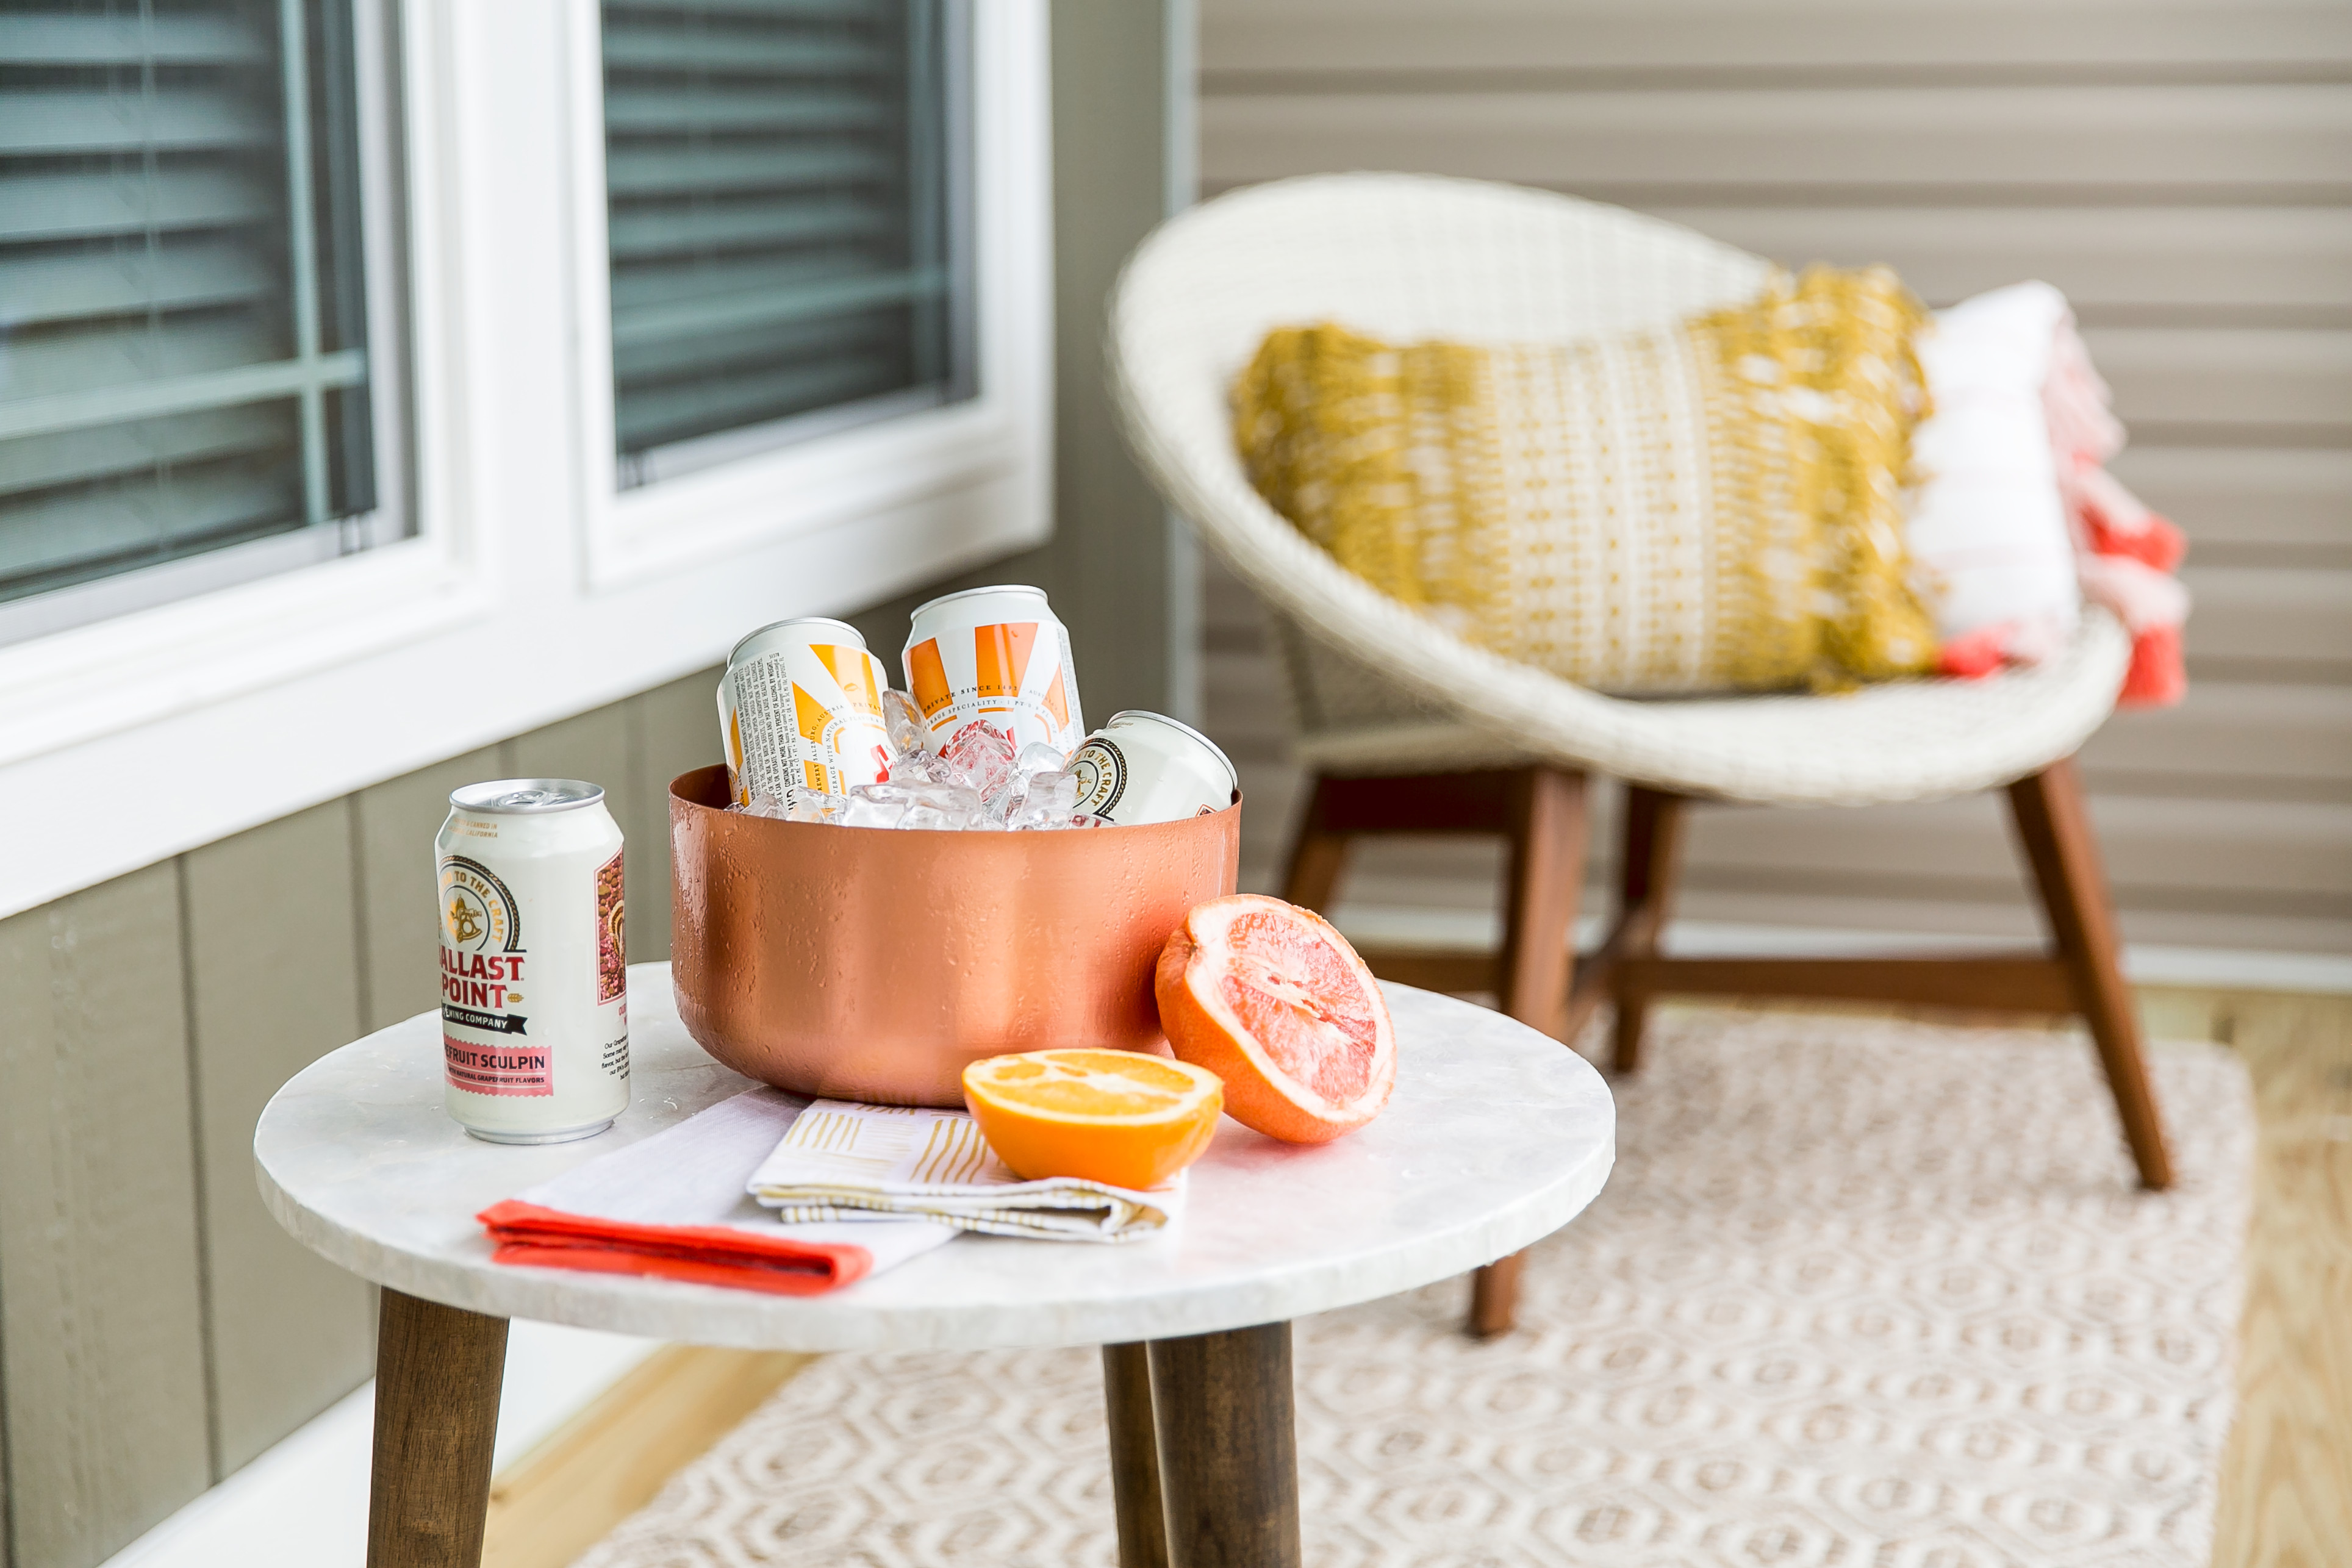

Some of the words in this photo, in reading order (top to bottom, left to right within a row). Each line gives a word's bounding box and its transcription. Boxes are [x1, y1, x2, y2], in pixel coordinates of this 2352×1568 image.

[754, 690, 763, 718] CONSUMPTION
[853, 702, 881, 712] PRIVAT
[923, 692, 956, 714] PRIVATE
[961, 685, 991, 694] SINCE
[948, 700, 997, 714] SPECIALITY
[818, 704, 844, 722] AUSTRIA
[825, 717, 848, 742] NATURAL
[810, 724, 819, 761] SALZBURG,
[1083, 750, 1096, 758] TO
[1094, 752, 1111, 770] THE
[813, 764, 823, 791] REWERY
[1091, 772, 1112, 806] CRAFT
[466, 829, 498, 839] CALIFORNIA
[470, 821, 490, 829] CANNED
[454, 870, 467, 883] TO
[470, 876, 490, 898] THE
[488, 899, 504, 943] CRAFT
[440, 945, 525, 981] ALLAST
[442, 972, 508, 1009] POINT
[465, 1013, 508, 1029] COMPANY
[444, 1042, 478, 1066] EFRUIT
[481, 1054, 545, 1070] SCULPIN
[603, 1051, 615, 1059] Some
[456, 1069, 476, 1081] NATURAL
[478, 1074, 514, 1083] GRAPEFRUIT
